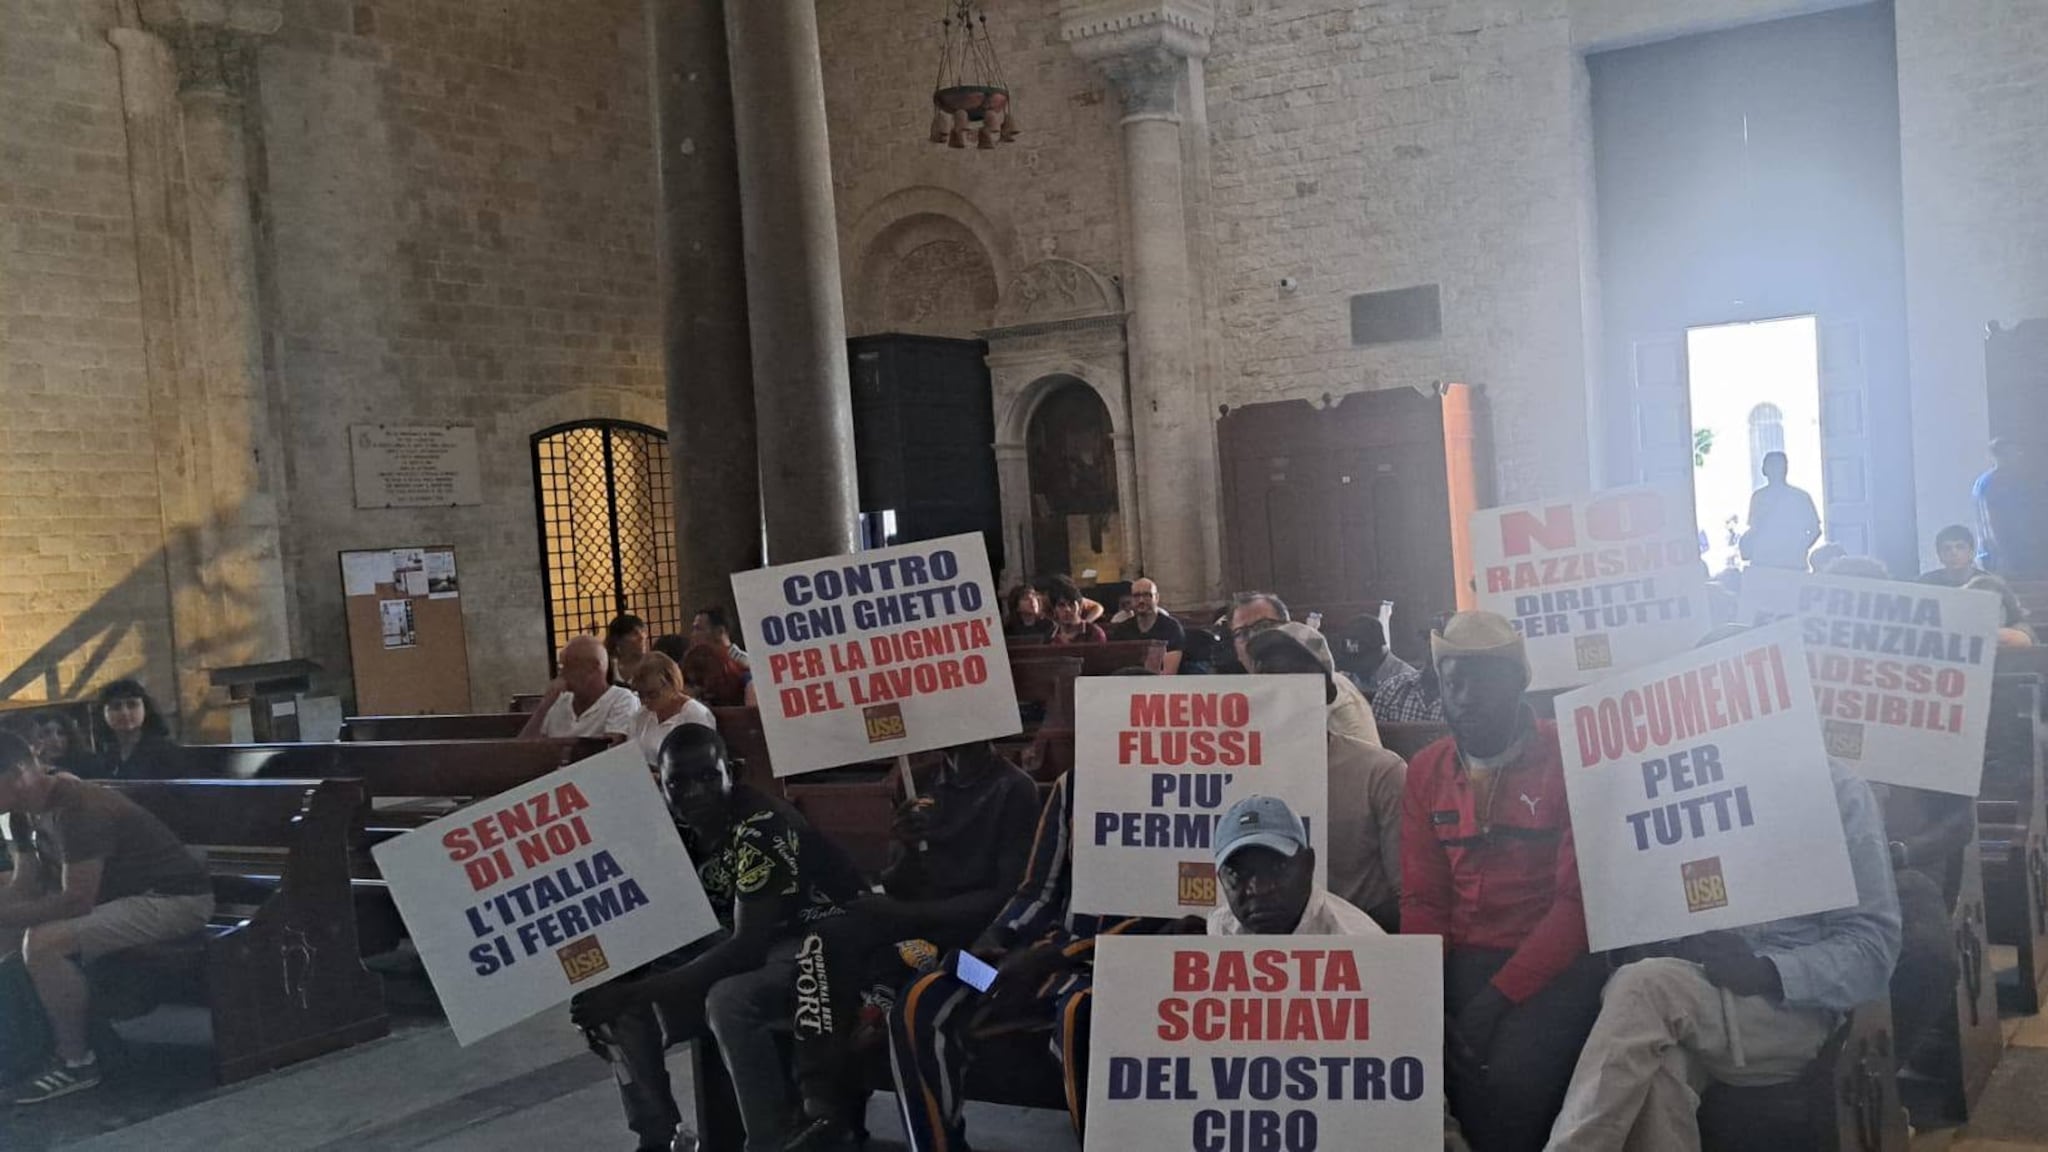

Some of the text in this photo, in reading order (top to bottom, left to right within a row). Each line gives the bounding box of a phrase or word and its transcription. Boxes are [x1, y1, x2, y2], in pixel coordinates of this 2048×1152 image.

[1500, 491, 1667, 558] NO
[783, 550, 958, 606] CONTRO
[1487, 539, 1692, 594] RAZZISMO
[761, 582, 982, 646] OGNI GHETTO
[1515, 577, 1656, 617] DIRITTI
[1578, 596, 1692, 631] TUTTI
[1800, 585, 1942, 627] PRIMA
[769, 618, 992, 684] PER LA DIGNITA'
[780, 654, 988, 718] DEL LAVORO
[1130, 692, 1249, 728] MENO
[1574, 644, 1792, 768] DOCUMENTI
[868, 716, 902, 737] USB
[1118, 731, 1262, 766] FLUSSI
[1151, 773, 1232, 808] PIU'
[1641, 744, 1724, 800] PER
[442, 782, 589, 862] SENZA
[1626, 786, 1754, 851] TUTTI
[464, 816, 592, 891] DI NOI
[465, 850, 624, 938] L'ITALIA
[1180, 878, 1216, 901] USB
[1687, 874, 1725, 902] USB
[469, 878, 650, 977] SI FERMA
[564, 949, 605, 977] USB
[793, 933, 822, 1041] SPORT
[1173, 949, 1361, 993] BASTA
[1157, 997, 1369, 1042] SCHIAVI
[1108, 1055, 1424, 1102] DEL VOSTRO
[1192, 1109, 1318, 1152] CIBO
